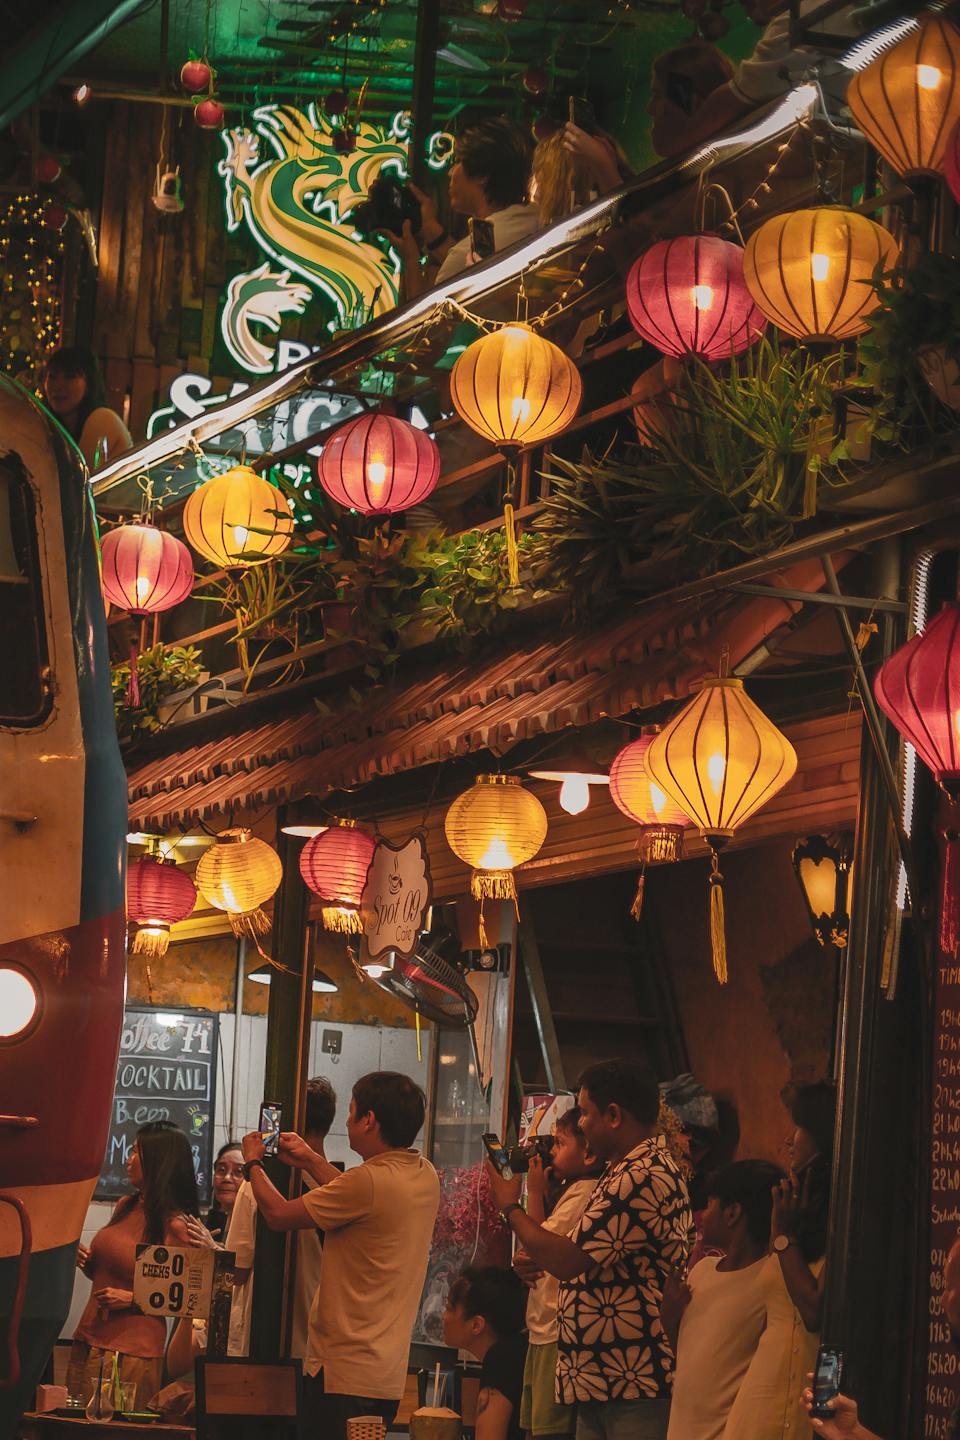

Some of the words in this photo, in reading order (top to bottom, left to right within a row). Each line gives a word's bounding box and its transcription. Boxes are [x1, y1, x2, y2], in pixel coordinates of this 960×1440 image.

[368, 895, 400, 935] Spot
[403, 889, 421, 922] 09
[121, 1017, 172, 1054] offee
[116, 1063, 206, 1091] OCKTAIL
